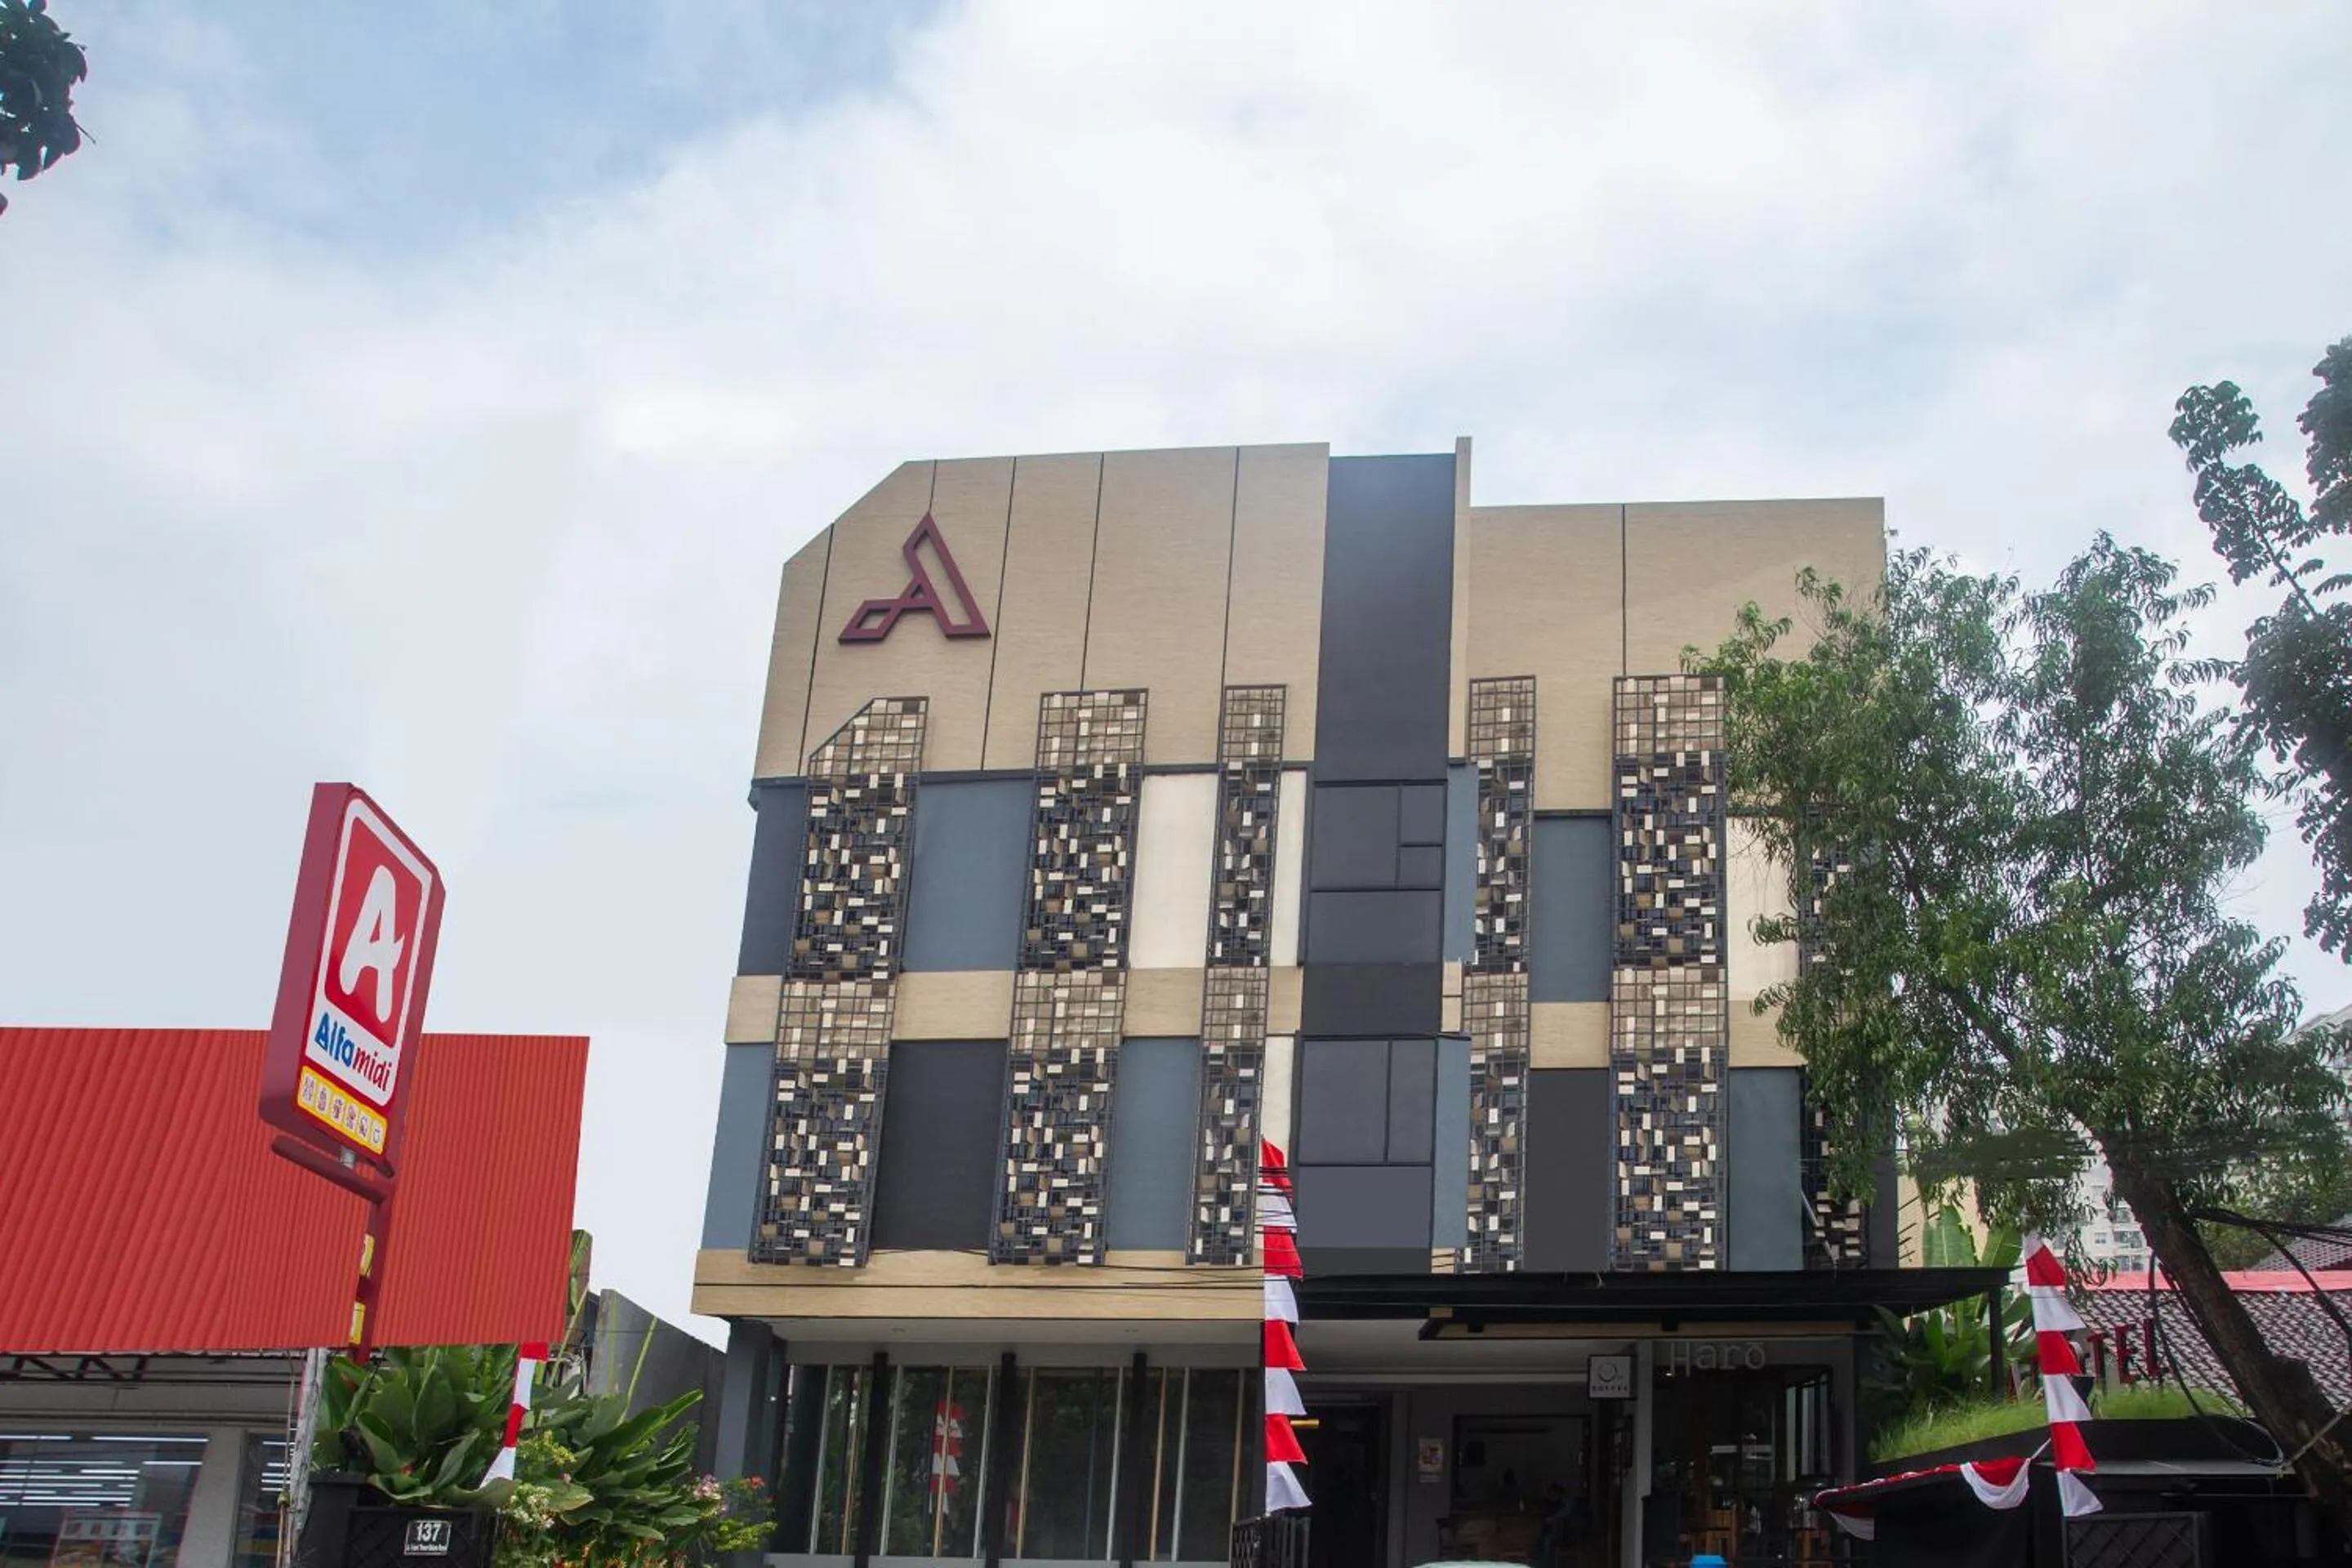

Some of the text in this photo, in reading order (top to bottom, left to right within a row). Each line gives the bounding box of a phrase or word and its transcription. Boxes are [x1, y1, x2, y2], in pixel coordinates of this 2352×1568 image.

[340, 864, 405, 1023] A
[314, 1012, 392, 1092] Alfamidi
[416, 1522, 442, 1542] 137
